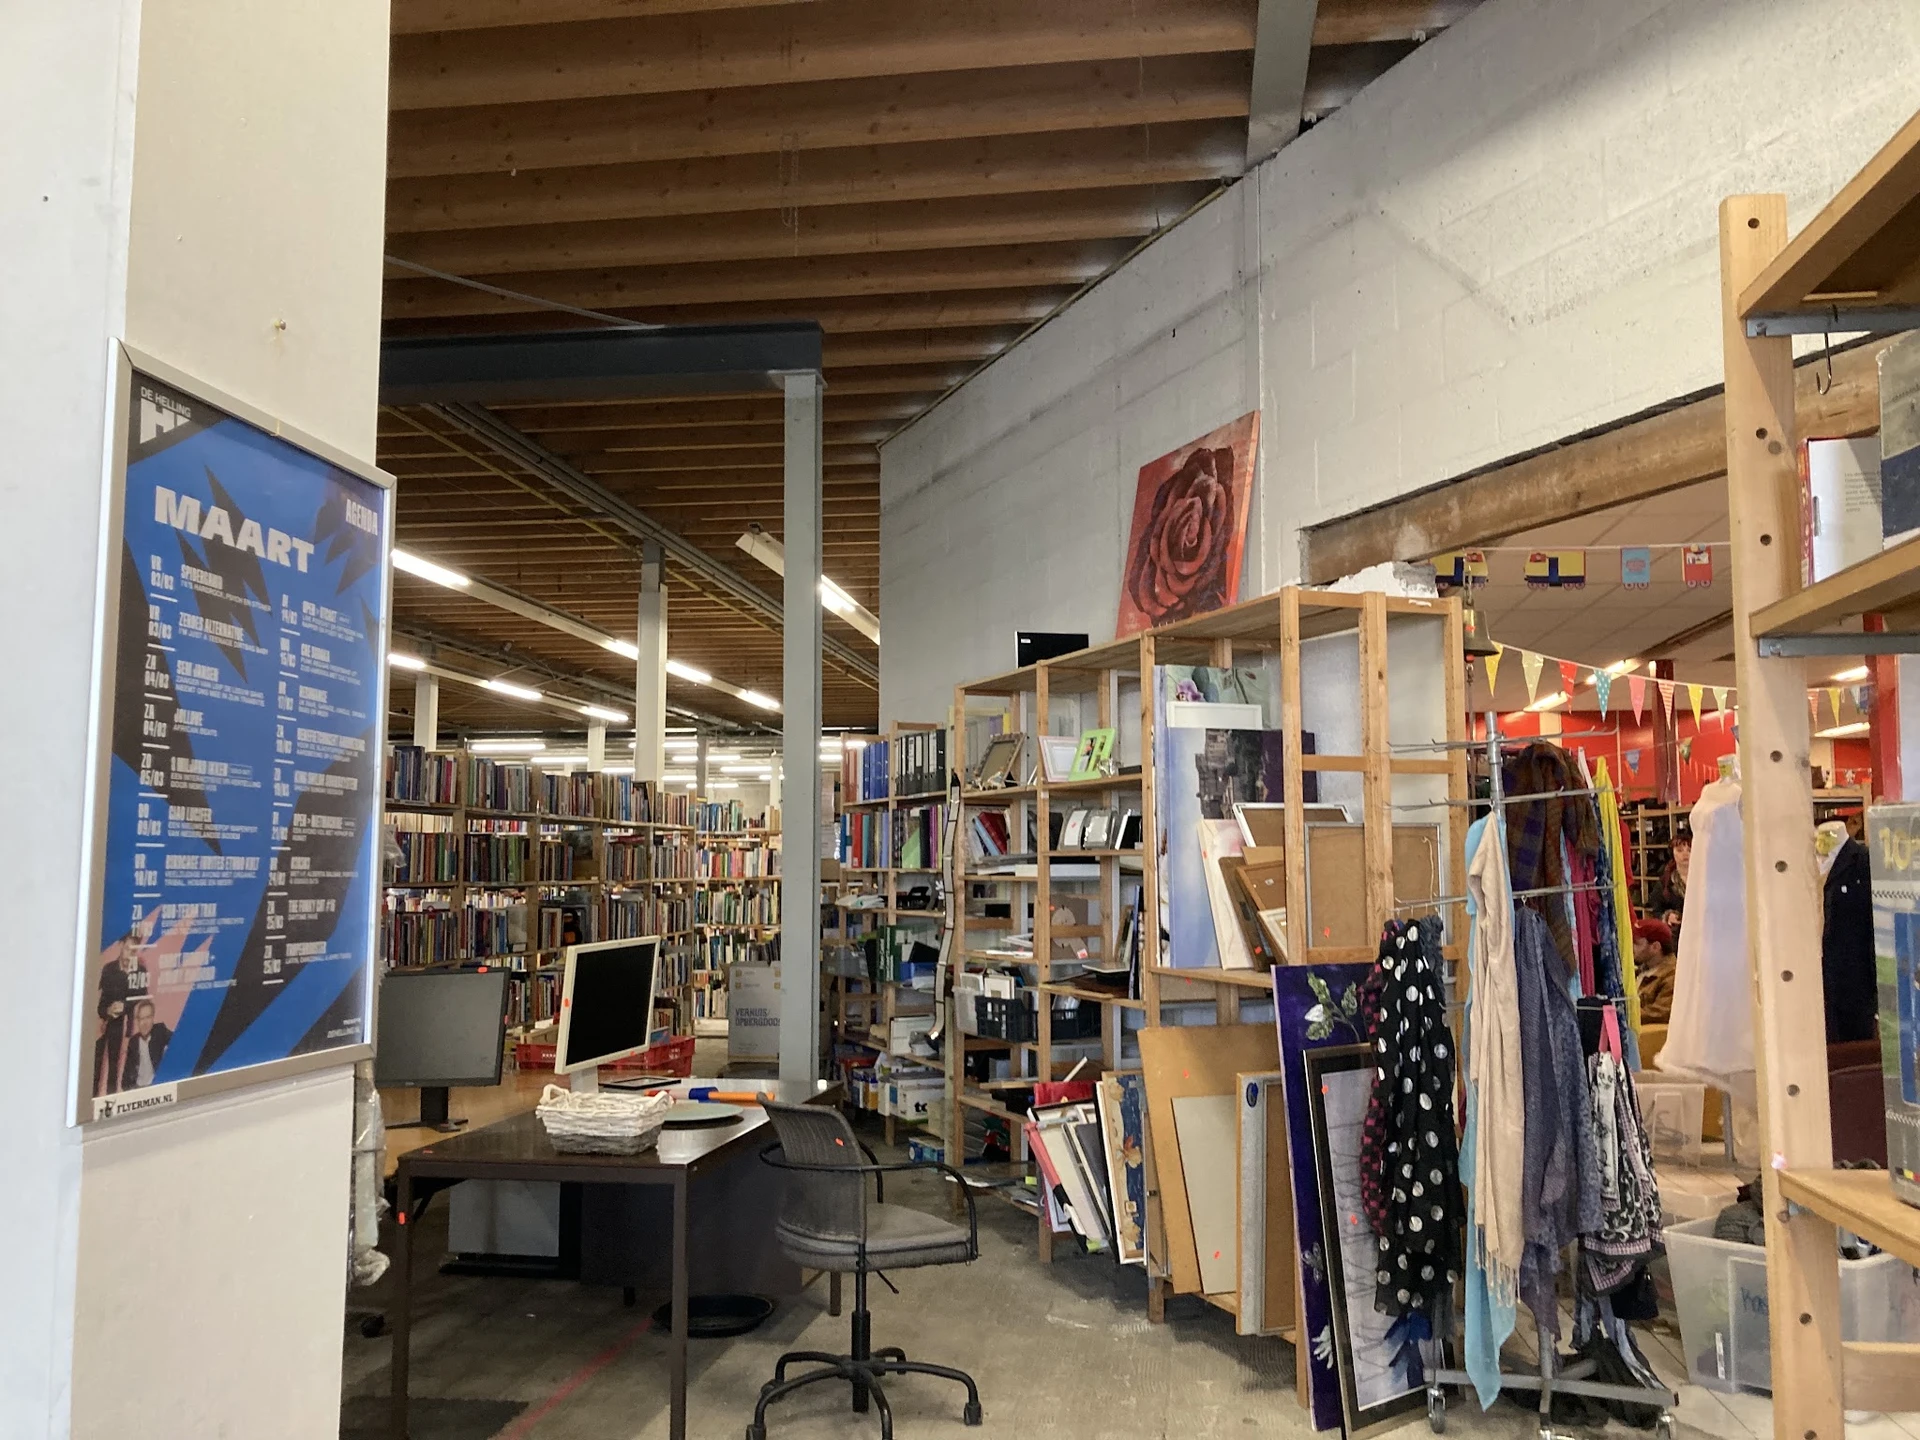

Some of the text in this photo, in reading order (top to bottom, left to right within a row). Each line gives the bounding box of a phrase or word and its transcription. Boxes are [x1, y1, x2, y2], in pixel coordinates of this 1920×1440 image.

[141, 386, 191, 420] DE HELLING
[346, 498, 378, 536] AGENDA
[154, 484, 314, 576] MAART
[151, 554, 162, 572] VR
[151, 570, 174, 592] 03/03
[149, 604, 160, 621] VR
[148, 620, 172, 641] 03/03
[205, 618, 244, 642] ALTERNATIVE
[145, 653, 156, 670] ZA
[144, 670, 169, 690] 04/03
[144, 703, 155, 720] ZA
[143, 720, 167, 738] 04/03
[141, 753, 152, 769] ZO
[139, 769, 164, 787] 05/03
[116, 1094, 174, 1115] FLYERMAN.NL
